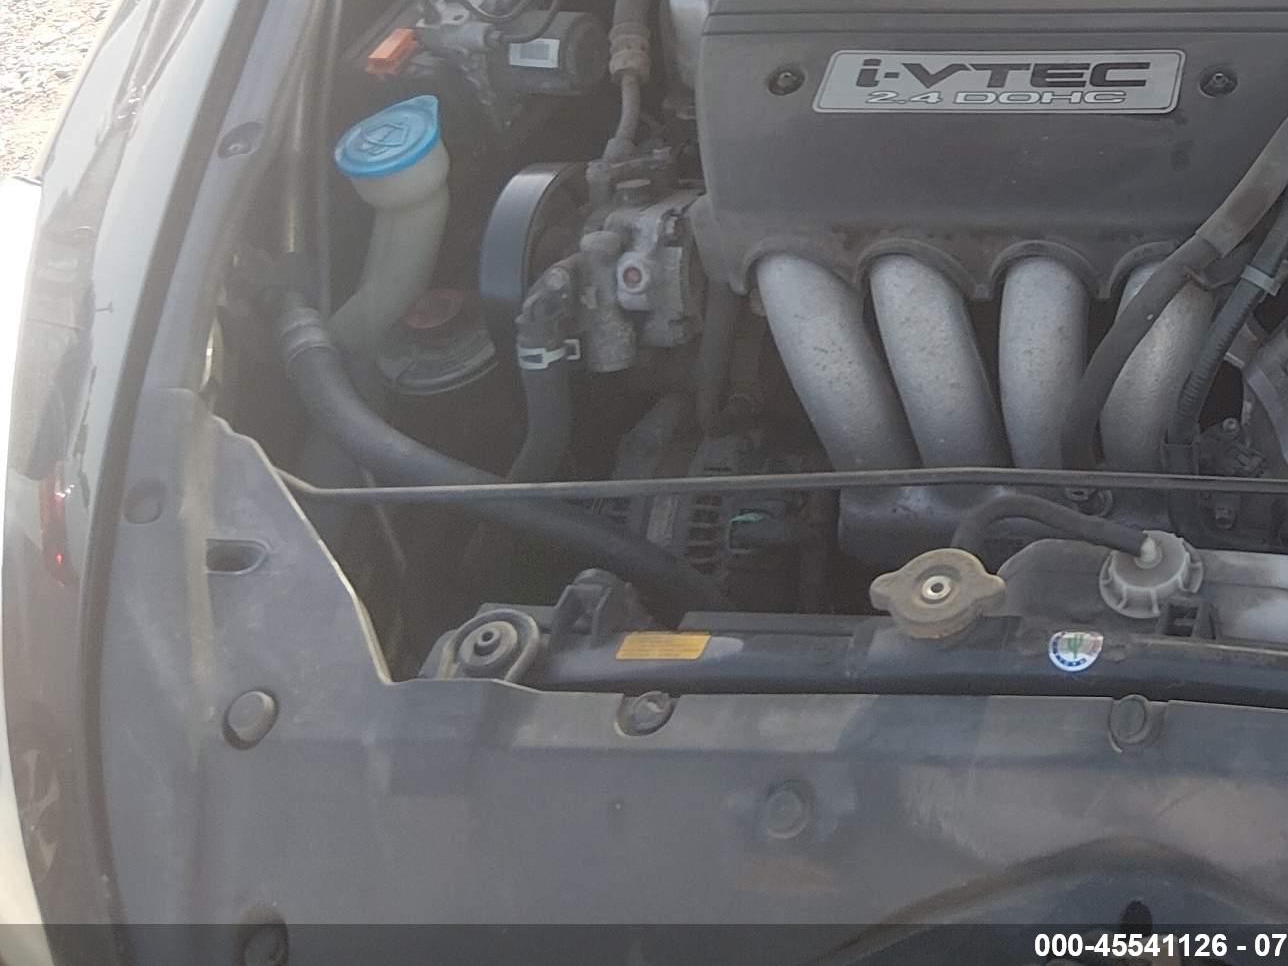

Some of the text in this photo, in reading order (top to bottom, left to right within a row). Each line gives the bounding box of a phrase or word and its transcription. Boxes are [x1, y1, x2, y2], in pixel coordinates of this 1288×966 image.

[855, 59, 1151, 89] i-VTEC
[865, 90, 1127, 105] 2.4 DOHC
